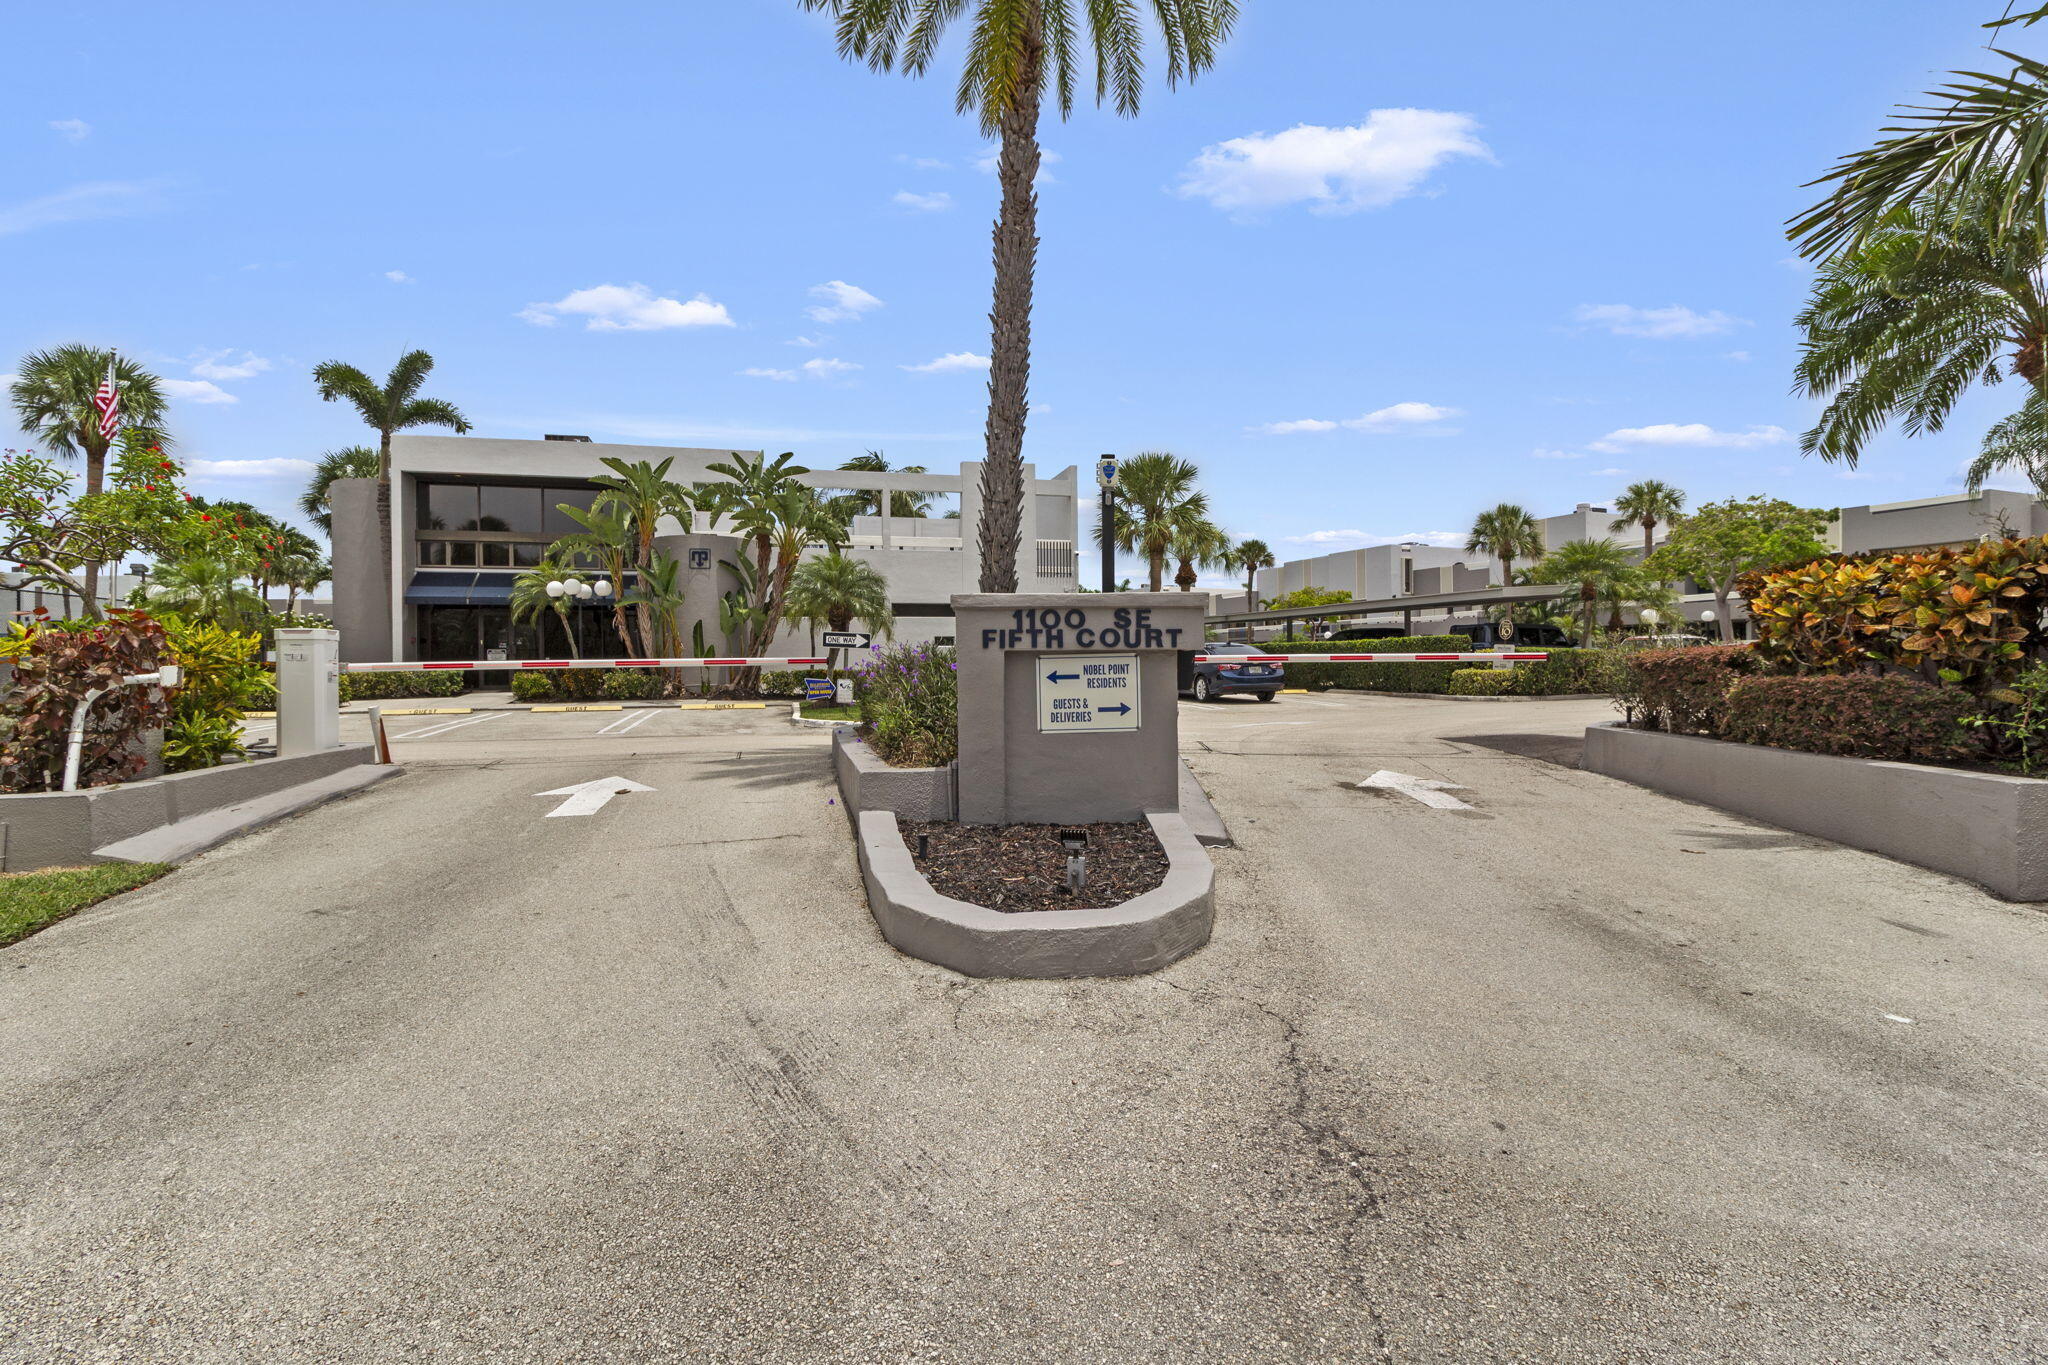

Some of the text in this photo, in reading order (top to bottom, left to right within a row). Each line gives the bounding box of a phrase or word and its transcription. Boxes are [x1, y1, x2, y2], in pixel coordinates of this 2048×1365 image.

[1012, 608, 1152, 631] 1100 SE
[842, 636, 857, 644] WAY
[982, 628, 1183, 649] FIFTH COURT
[1083, 663, 1130, 675] NOBEL POINT
[1087, 677, 1127, 689] RESIDENTS
[1053, 698, 1089, 710] GUESTS &
[1050, 711, 1092, 723] DELIVERIES
